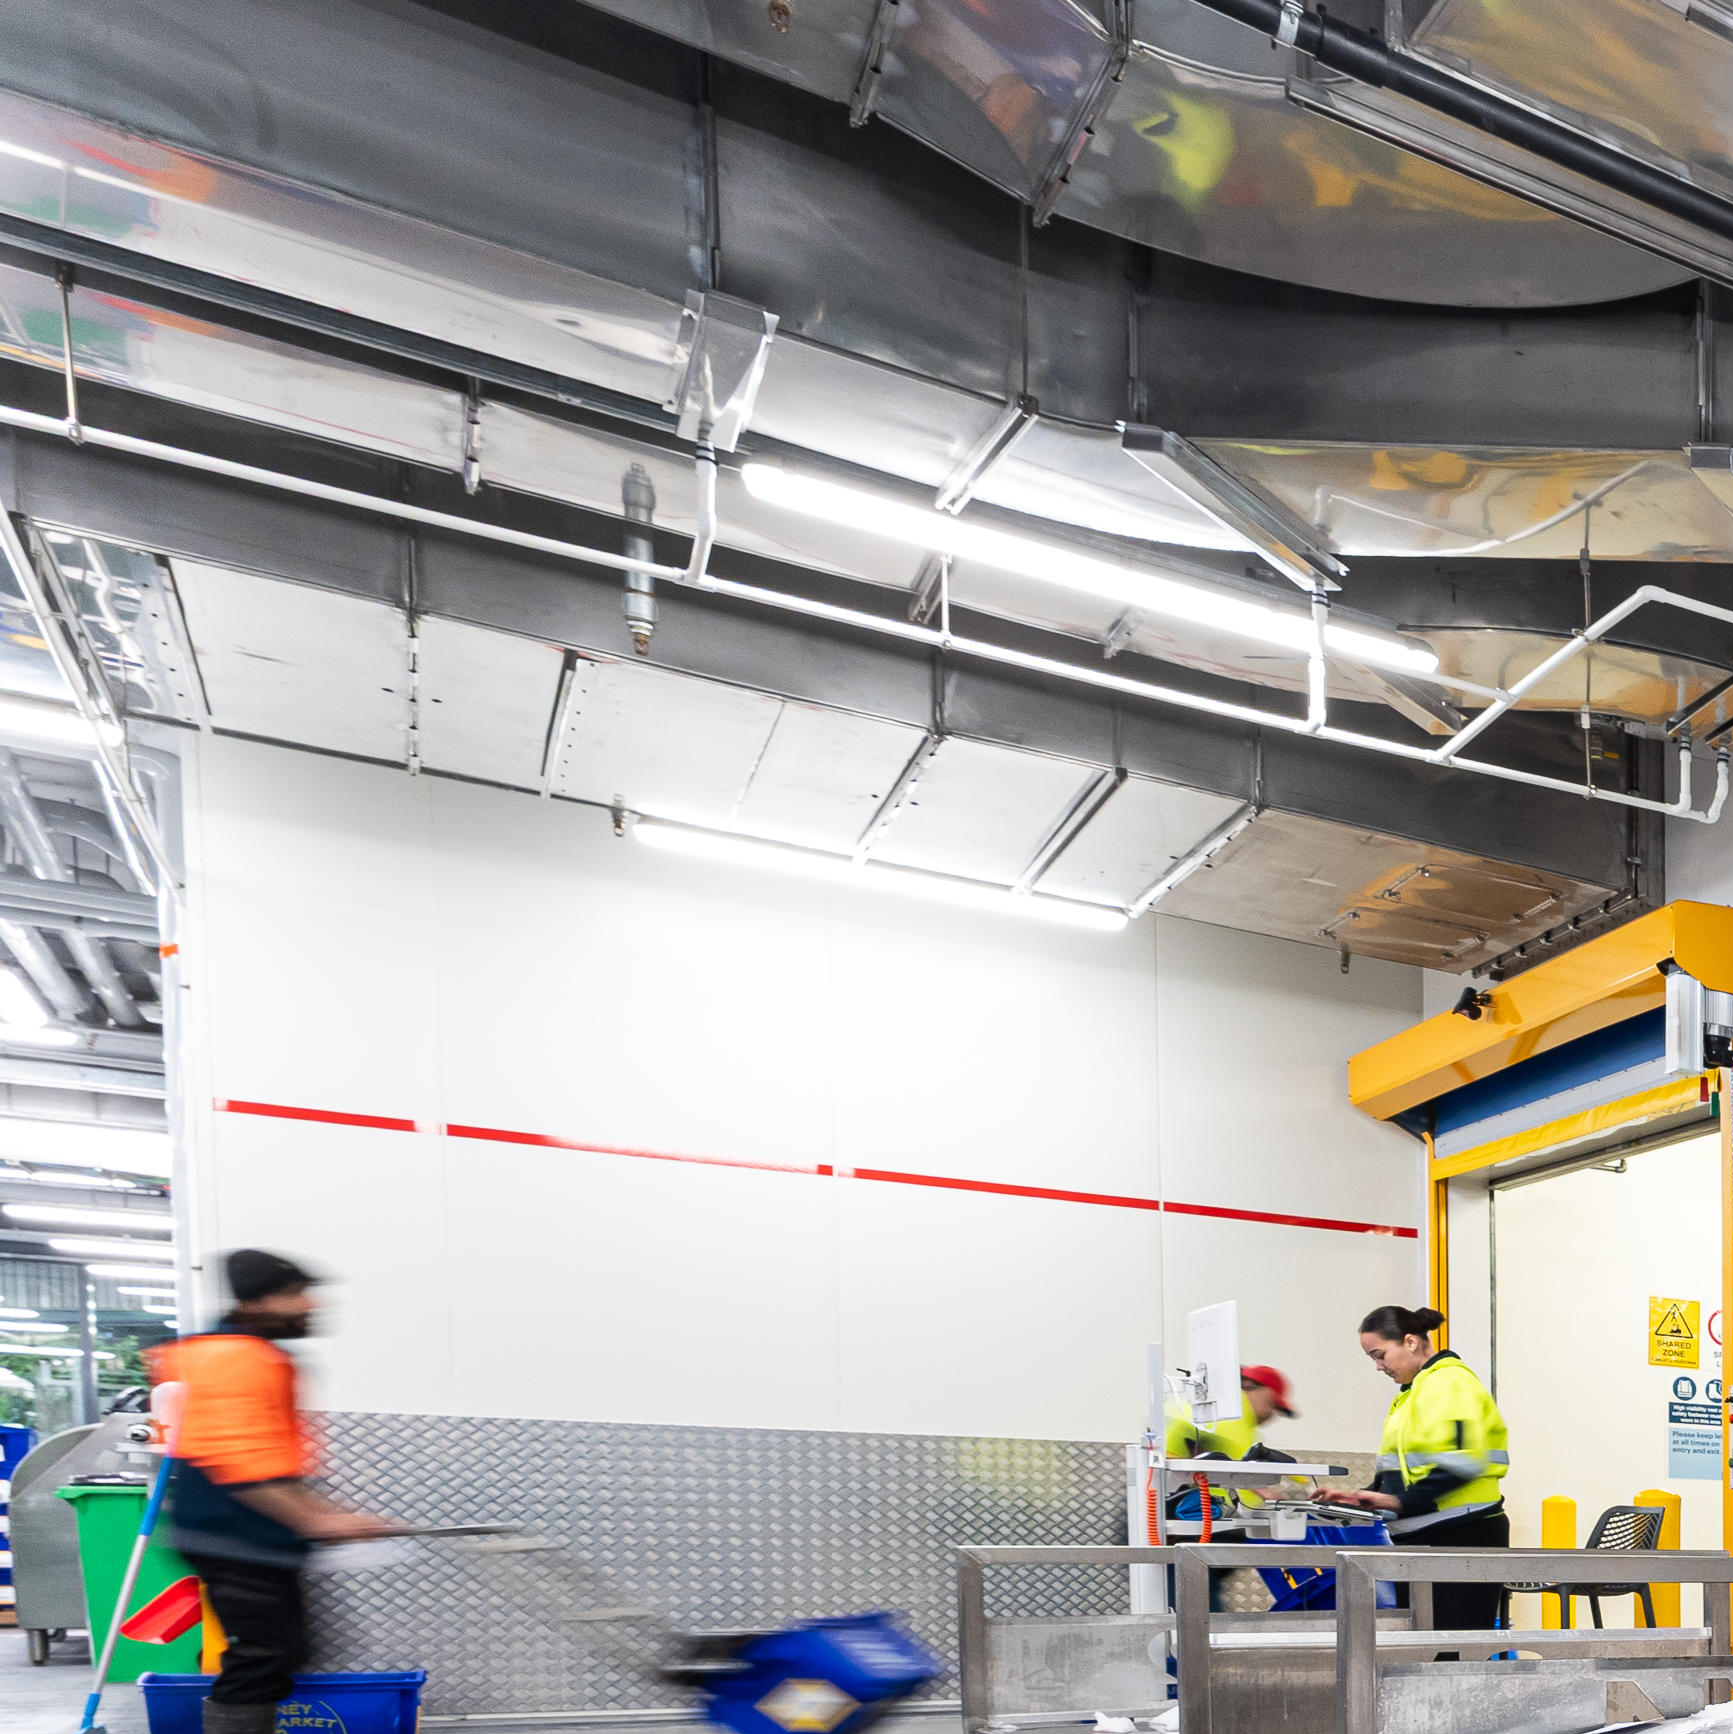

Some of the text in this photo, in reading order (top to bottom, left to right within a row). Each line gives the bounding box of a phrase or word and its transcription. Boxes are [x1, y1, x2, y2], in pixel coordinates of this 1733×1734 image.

[1657, 1340, 1691, 1349] SHARED
[1663, 1349, 1685, 1357] ZONE
[278, 1716, 336, 1728] ARKET
